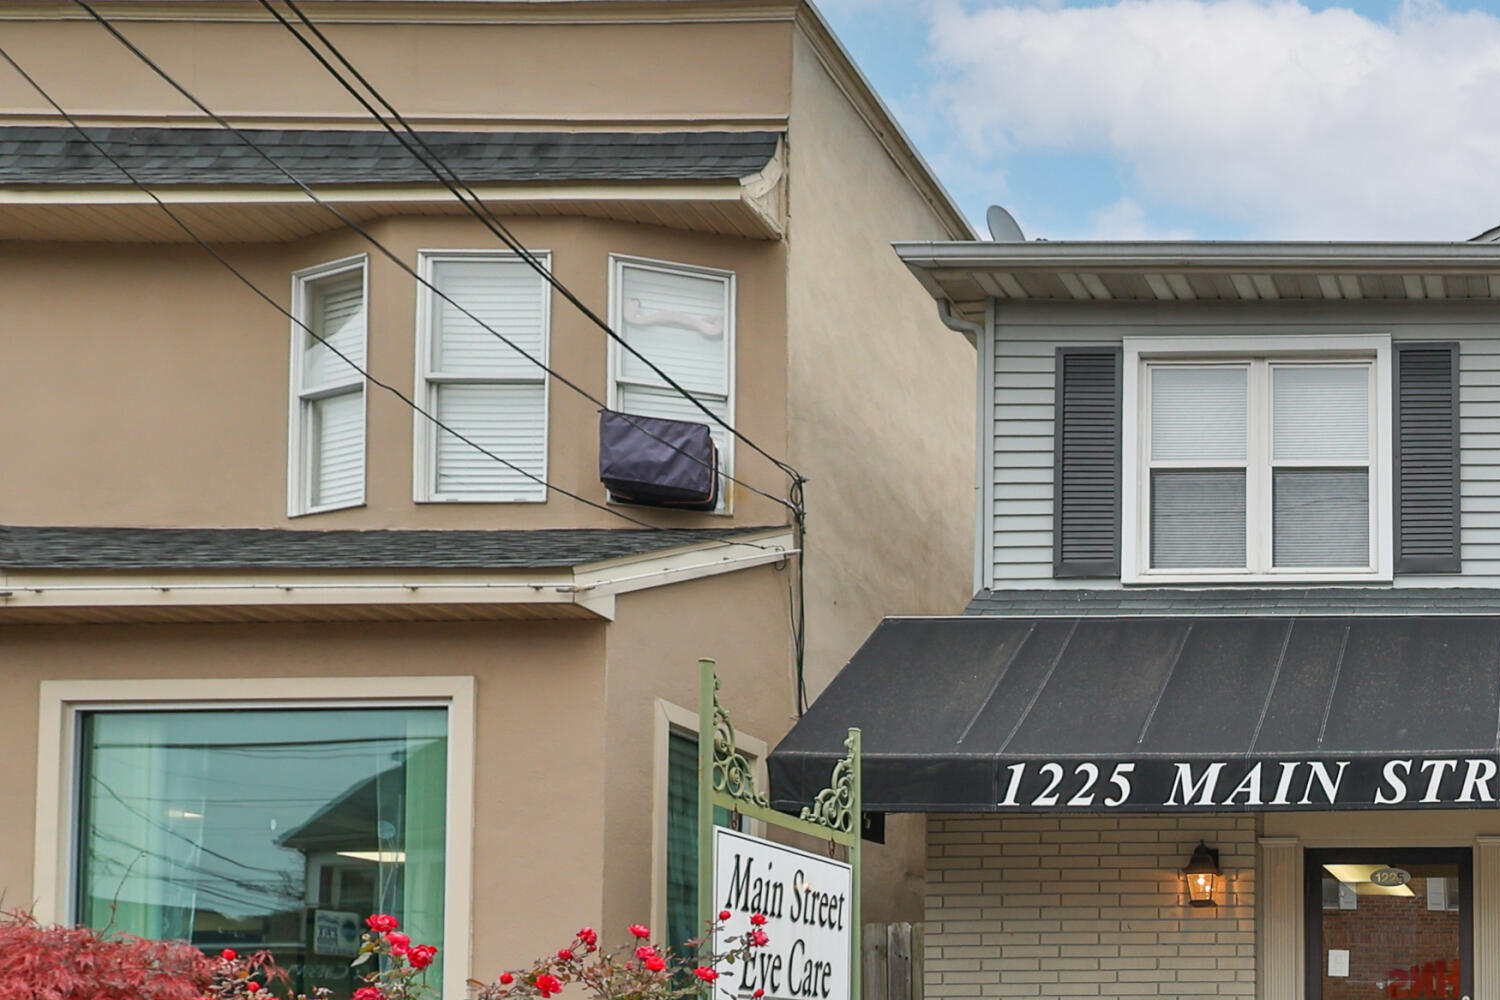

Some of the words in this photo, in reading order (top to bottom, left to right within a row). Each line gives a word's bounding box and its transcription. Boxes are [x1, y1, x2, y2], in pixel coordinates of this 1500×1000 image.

[997, 762, 1136, 807] 1225
[1162, 760, 1353, 806] MAIN
[725, 853, 784, 919] Main
[790, 869, 845, 932] Street
[1375, 871, 1405, 884] 1225
[788, 938, 832, 999] Care
